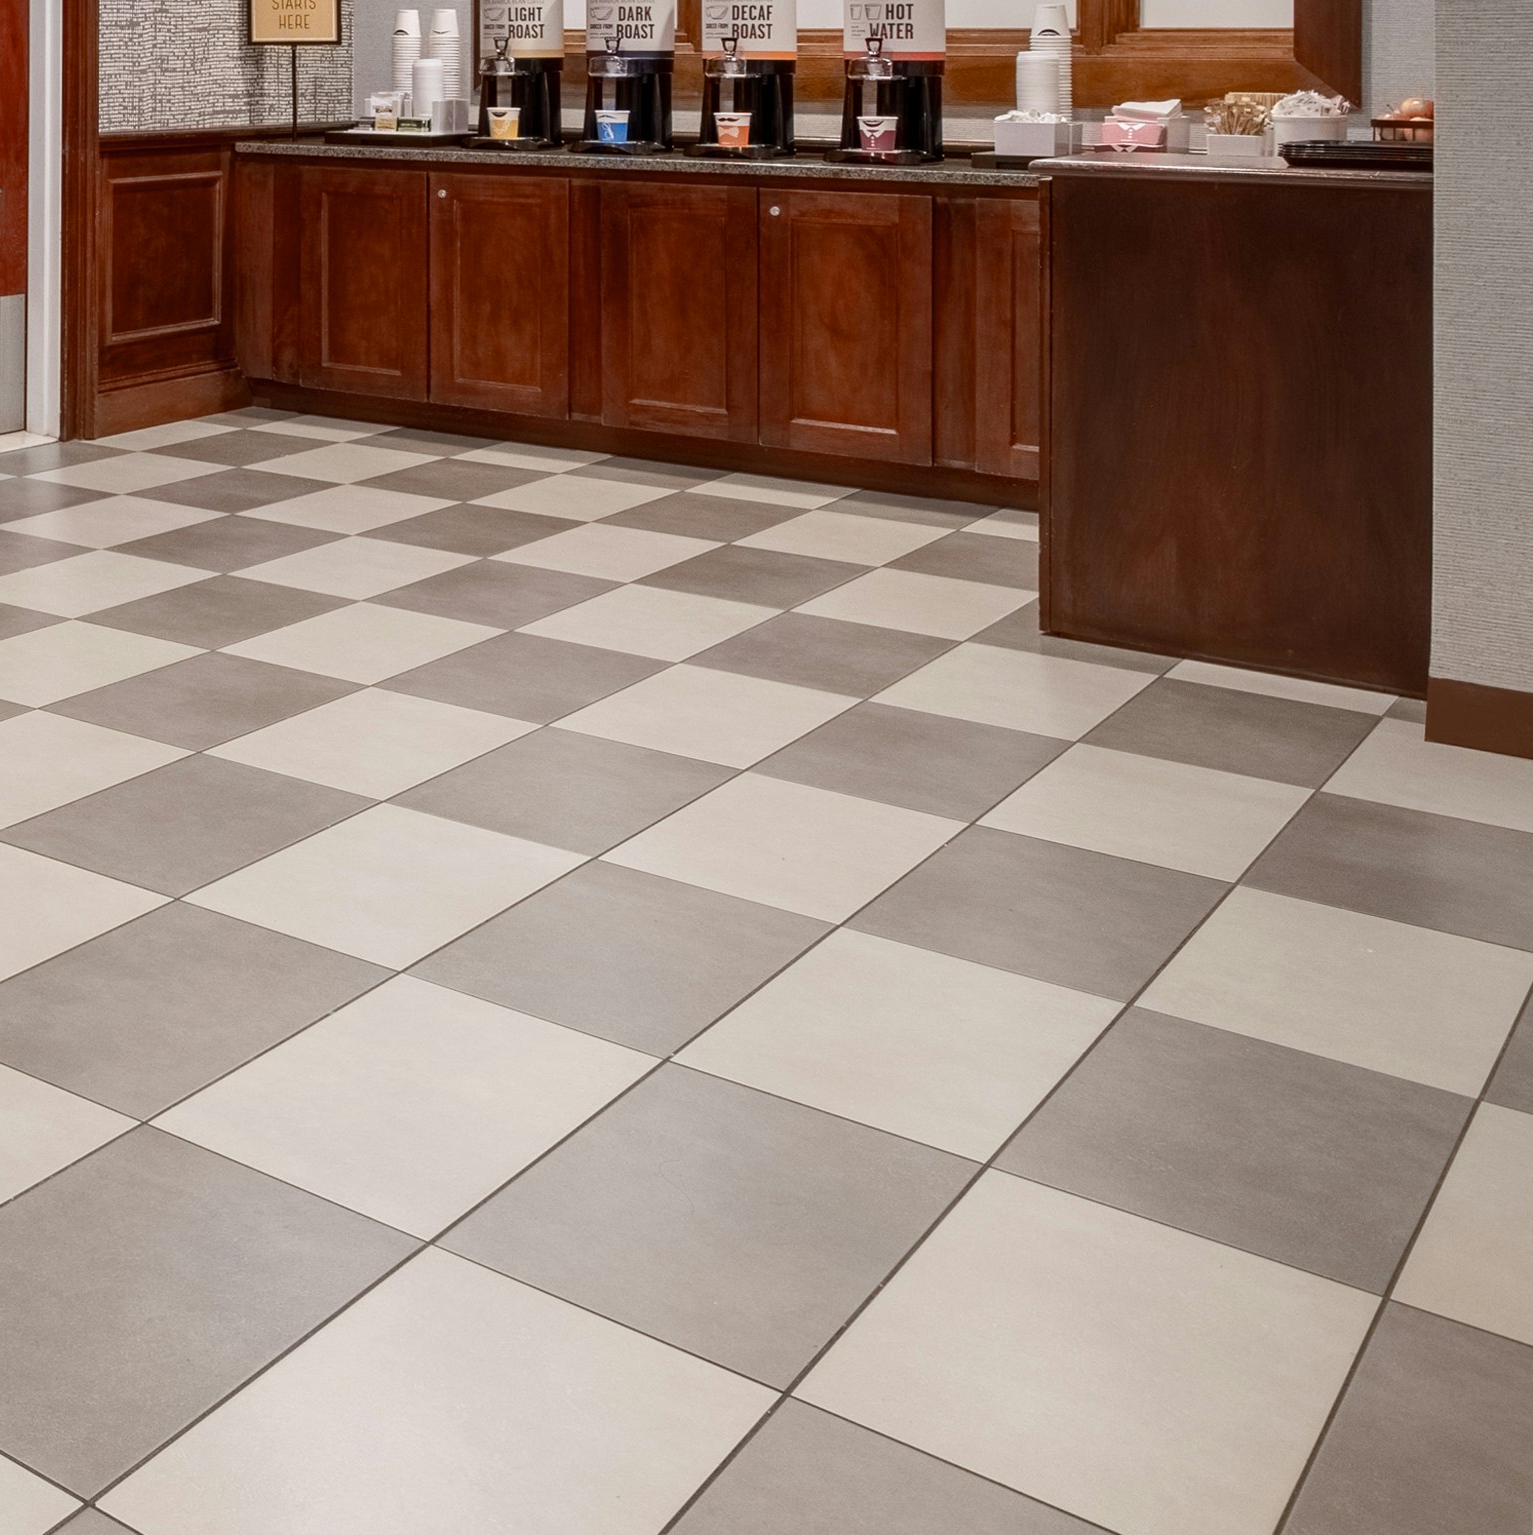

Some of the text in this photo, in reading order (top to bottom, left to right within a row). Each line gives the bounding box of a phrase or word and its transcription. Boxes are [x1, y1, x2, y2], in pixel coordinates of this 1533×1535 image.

[508, 7, 543, 22] LIGHT
[618, 6, 652, 21] DARK
[732, 5, 773, 21] DECAF
[885, 3, 914, 20] HOT
[278, 14, 310, 29] HERE
[508, 24, 545, 39] ROAST
[616, 24, 655, 39] ROAST
[732, 23, 773, 39] ROAST
[869, 23, 914, 39] WATER
